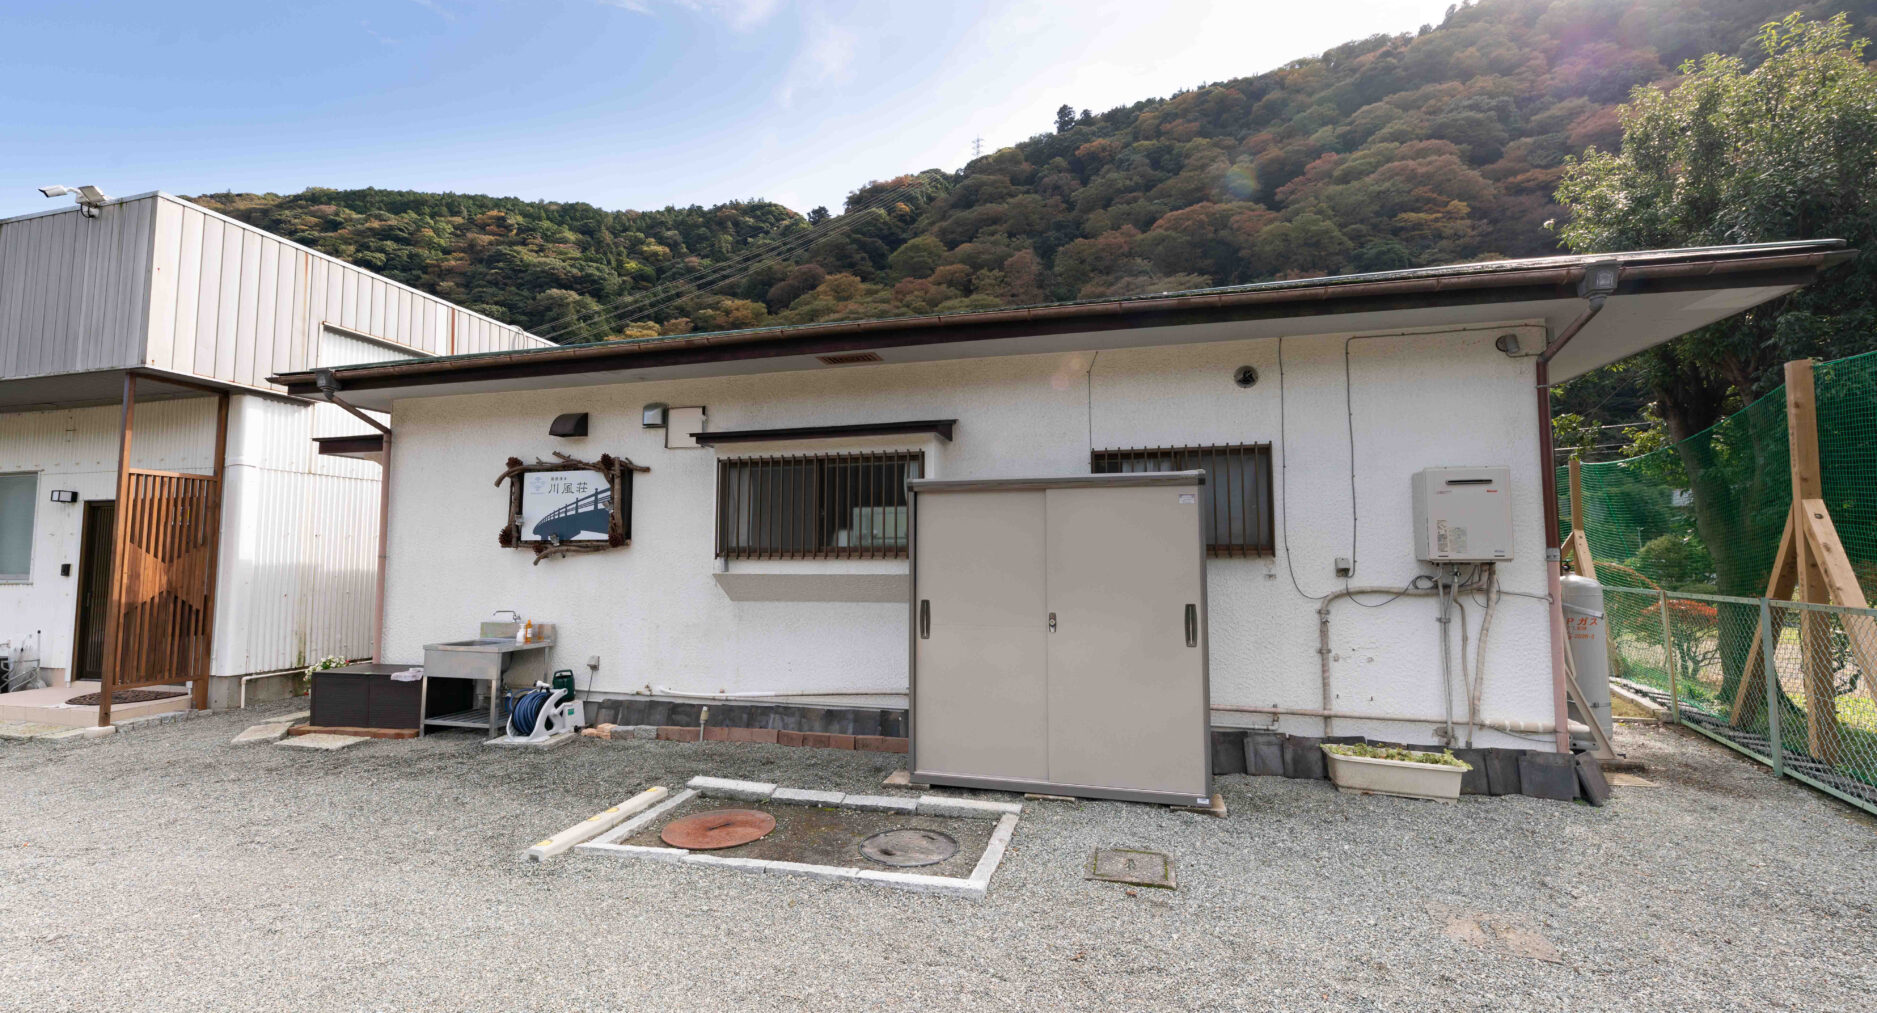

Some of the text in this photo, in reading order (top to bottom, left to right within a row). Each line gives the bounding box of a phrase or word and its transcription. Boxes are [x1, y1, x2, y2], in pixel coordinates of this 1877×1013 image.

[548, 481, 588, 494] 川風荘
[1566, 616, 1598, 626] Pガス
